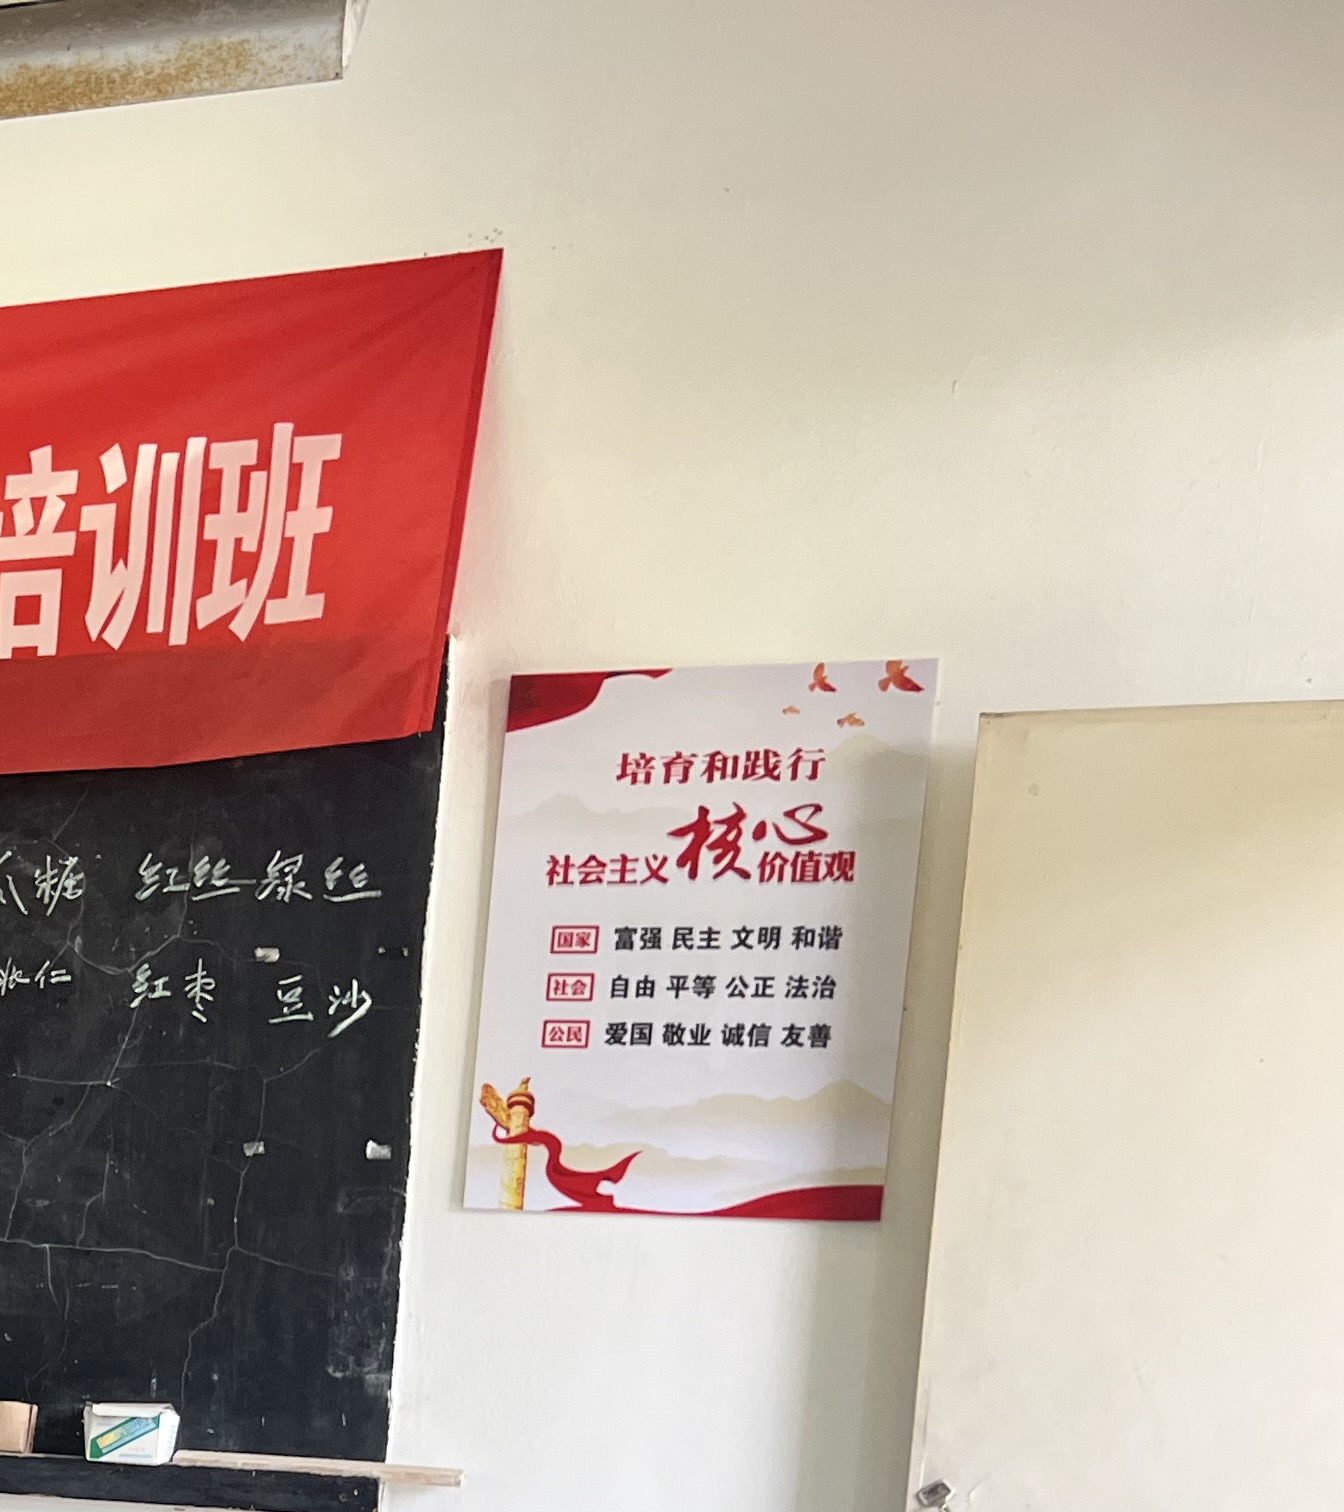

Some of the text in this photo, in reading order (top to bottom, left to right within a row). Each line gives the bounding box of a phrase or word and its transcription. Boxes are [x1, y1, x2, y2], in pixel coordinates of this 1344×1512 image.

[615, 747, 826, 785] 培育和践行
[546, 801, 857, 886] 社会主义 核心 价值观
[556, 925, 843, 950] 国家 富强 民主 文明 和谐
[129, 957, 216, 1023] 红枣
[268, 975, 373, 1038] 豆沙
[553, 974, 837, 999] 社会 自由 平等 公正 法治
[548, 1022, 832, 1048] 公民 爱国 敬业 诚信 友善
